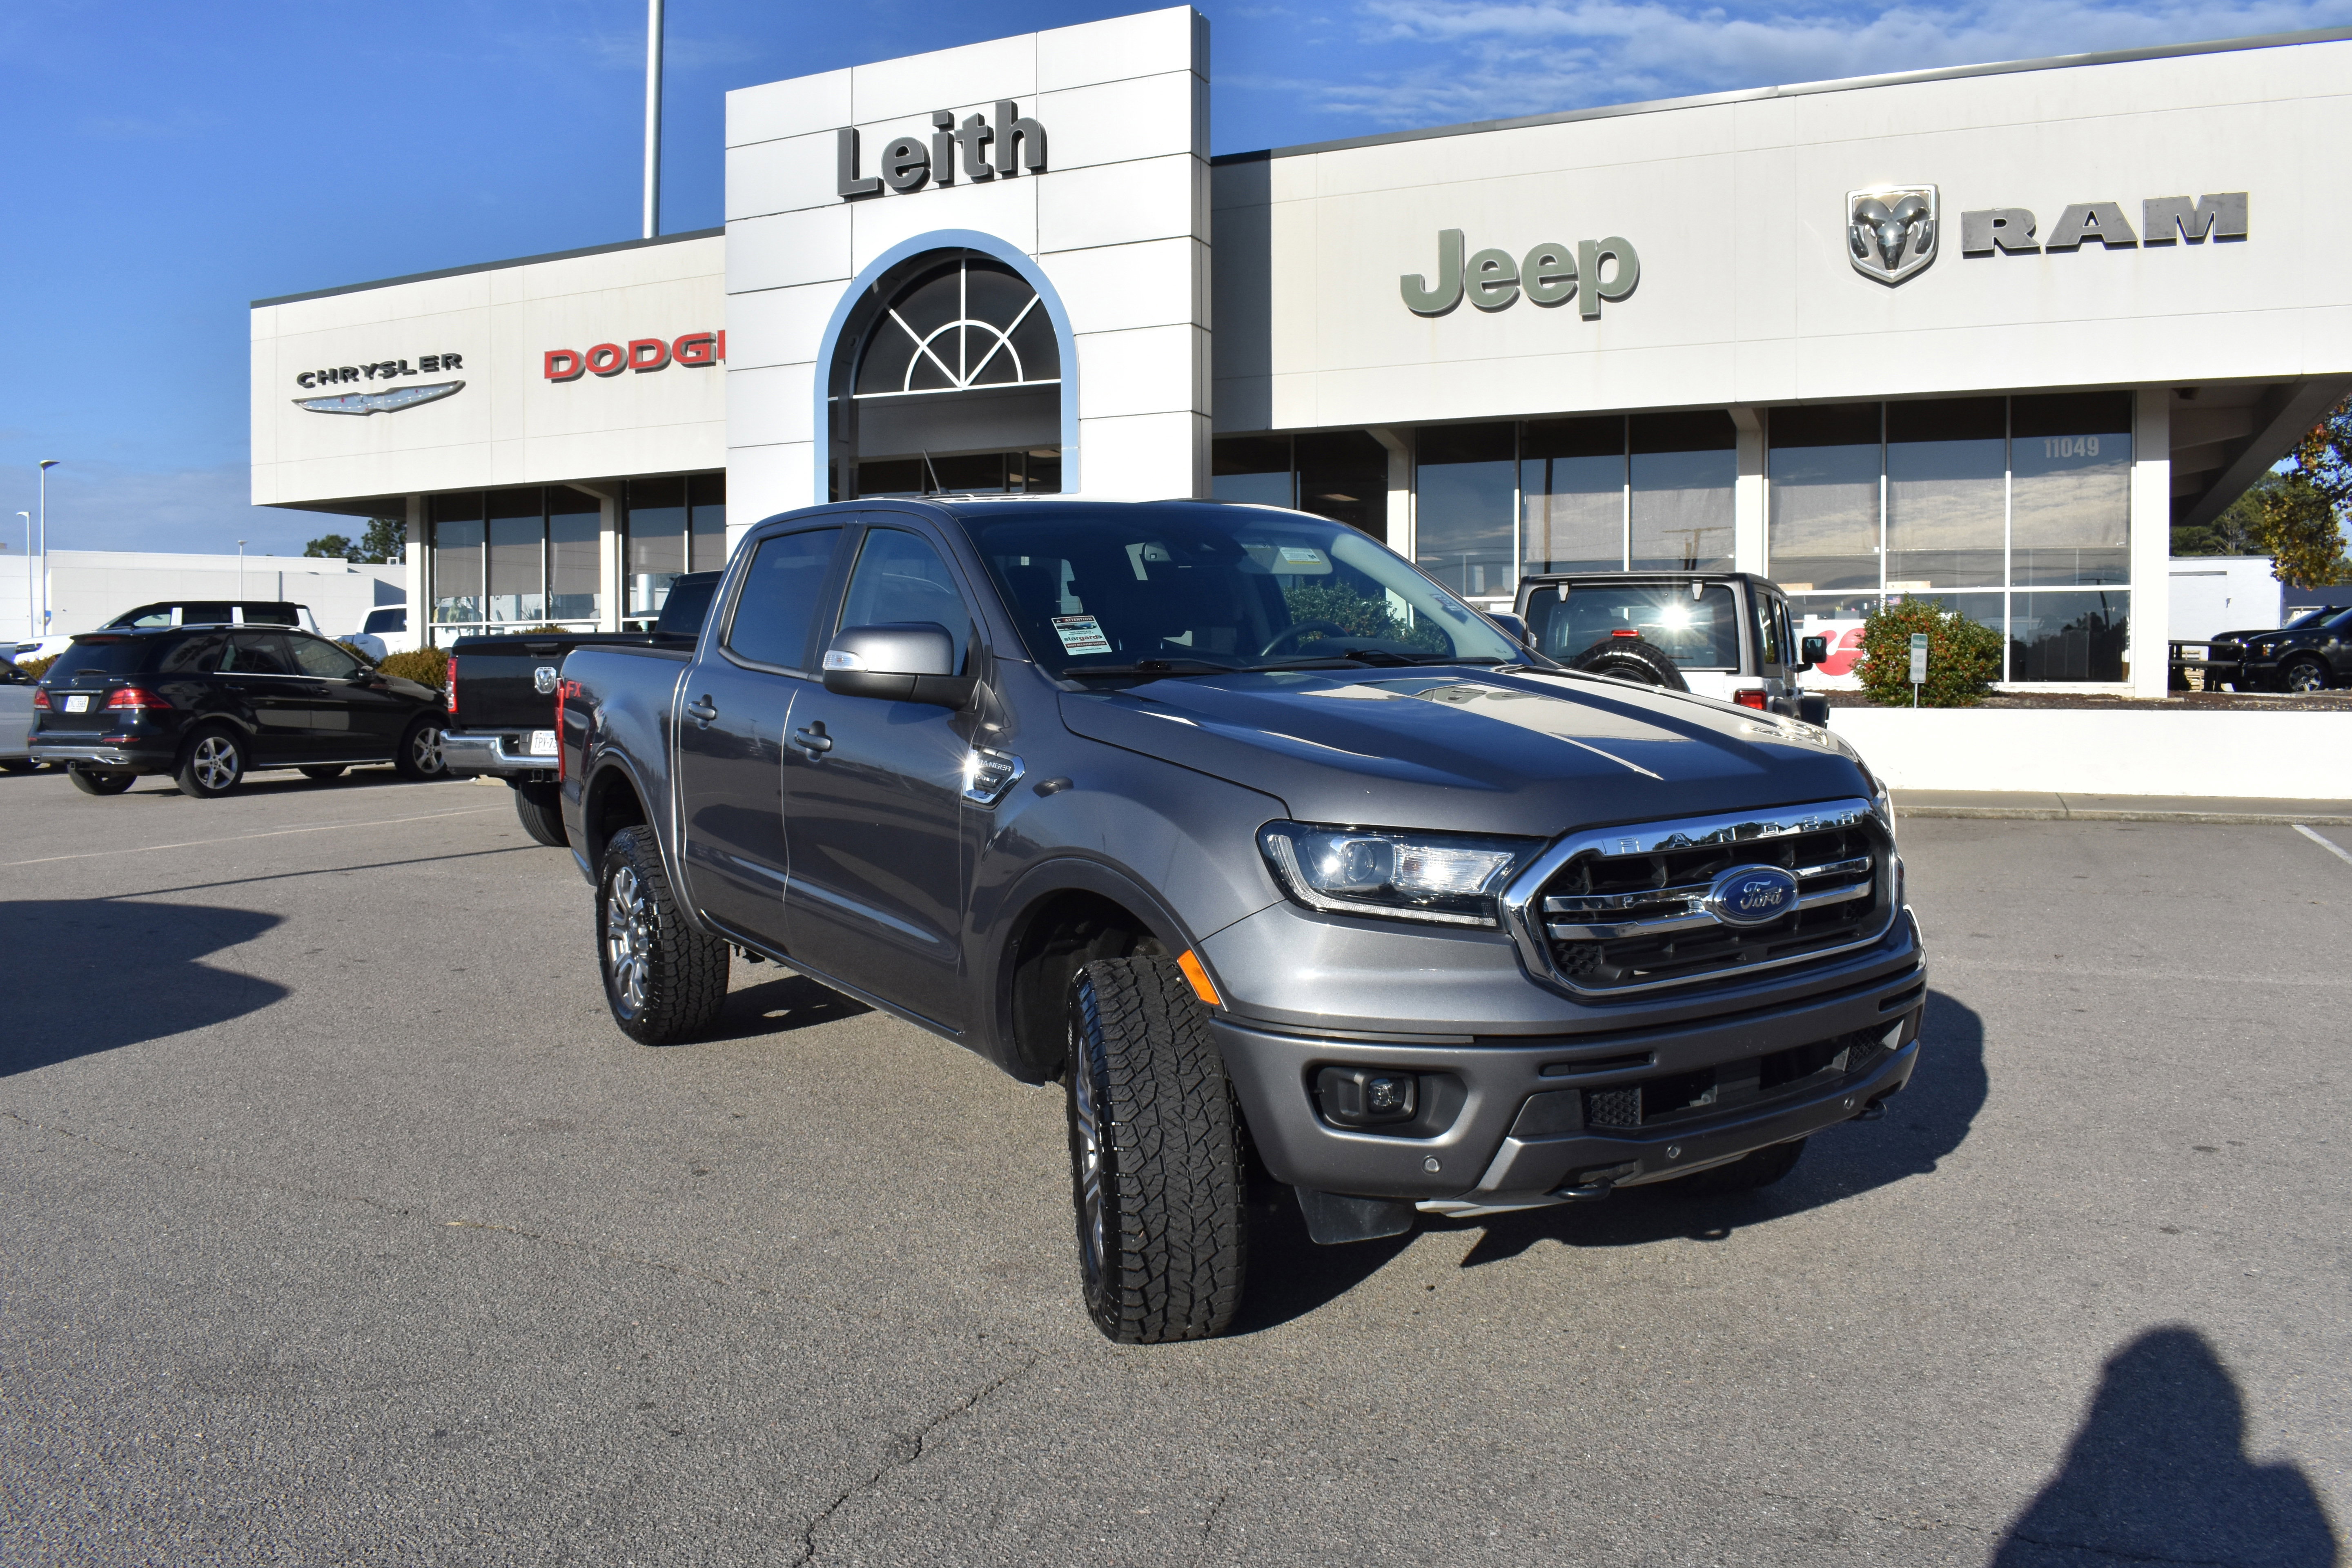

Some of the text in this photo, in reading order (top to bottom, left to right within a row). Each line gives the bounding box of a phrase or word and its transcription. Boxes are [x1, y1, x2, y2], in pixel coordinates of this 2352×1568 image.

[837, 100, 1047, 200] Leith
[1961, 192, 2248, 257] RAM
[1399, 228, 1639, 321] Jeep
[296, 353, 463, 388] CHRYSLER
[544, 329, 725, 381] DODG
[2044, 436, 2099, 458] 11049
[975, 774, 997, 783] LARIAT
[977, 759, 1011, 772] RANGER
[1740, 880, 1784, 910] Ford
